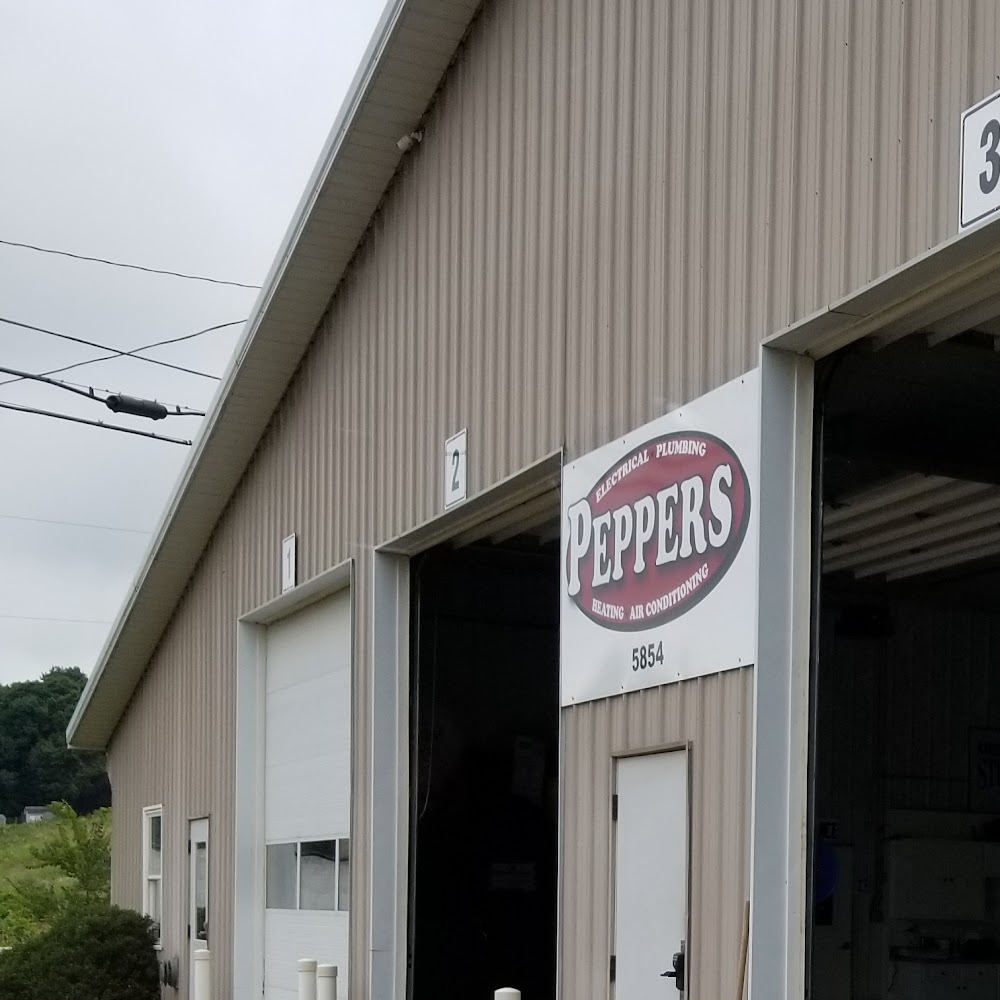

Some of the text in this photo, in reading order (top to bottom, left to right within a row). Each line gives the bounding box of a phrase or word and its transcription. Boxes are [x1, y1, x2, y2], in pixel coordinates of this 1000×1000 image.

[451, 448, 460, 492] 2
[595, 440, 707, 504] ELECTRICAL PLUMBING
[567, 463, 733, 597] PEPPERS
[591, 562, 709, 621] HEATING AIR CONDITIONING
[631, 640, 665, 672] 5854
